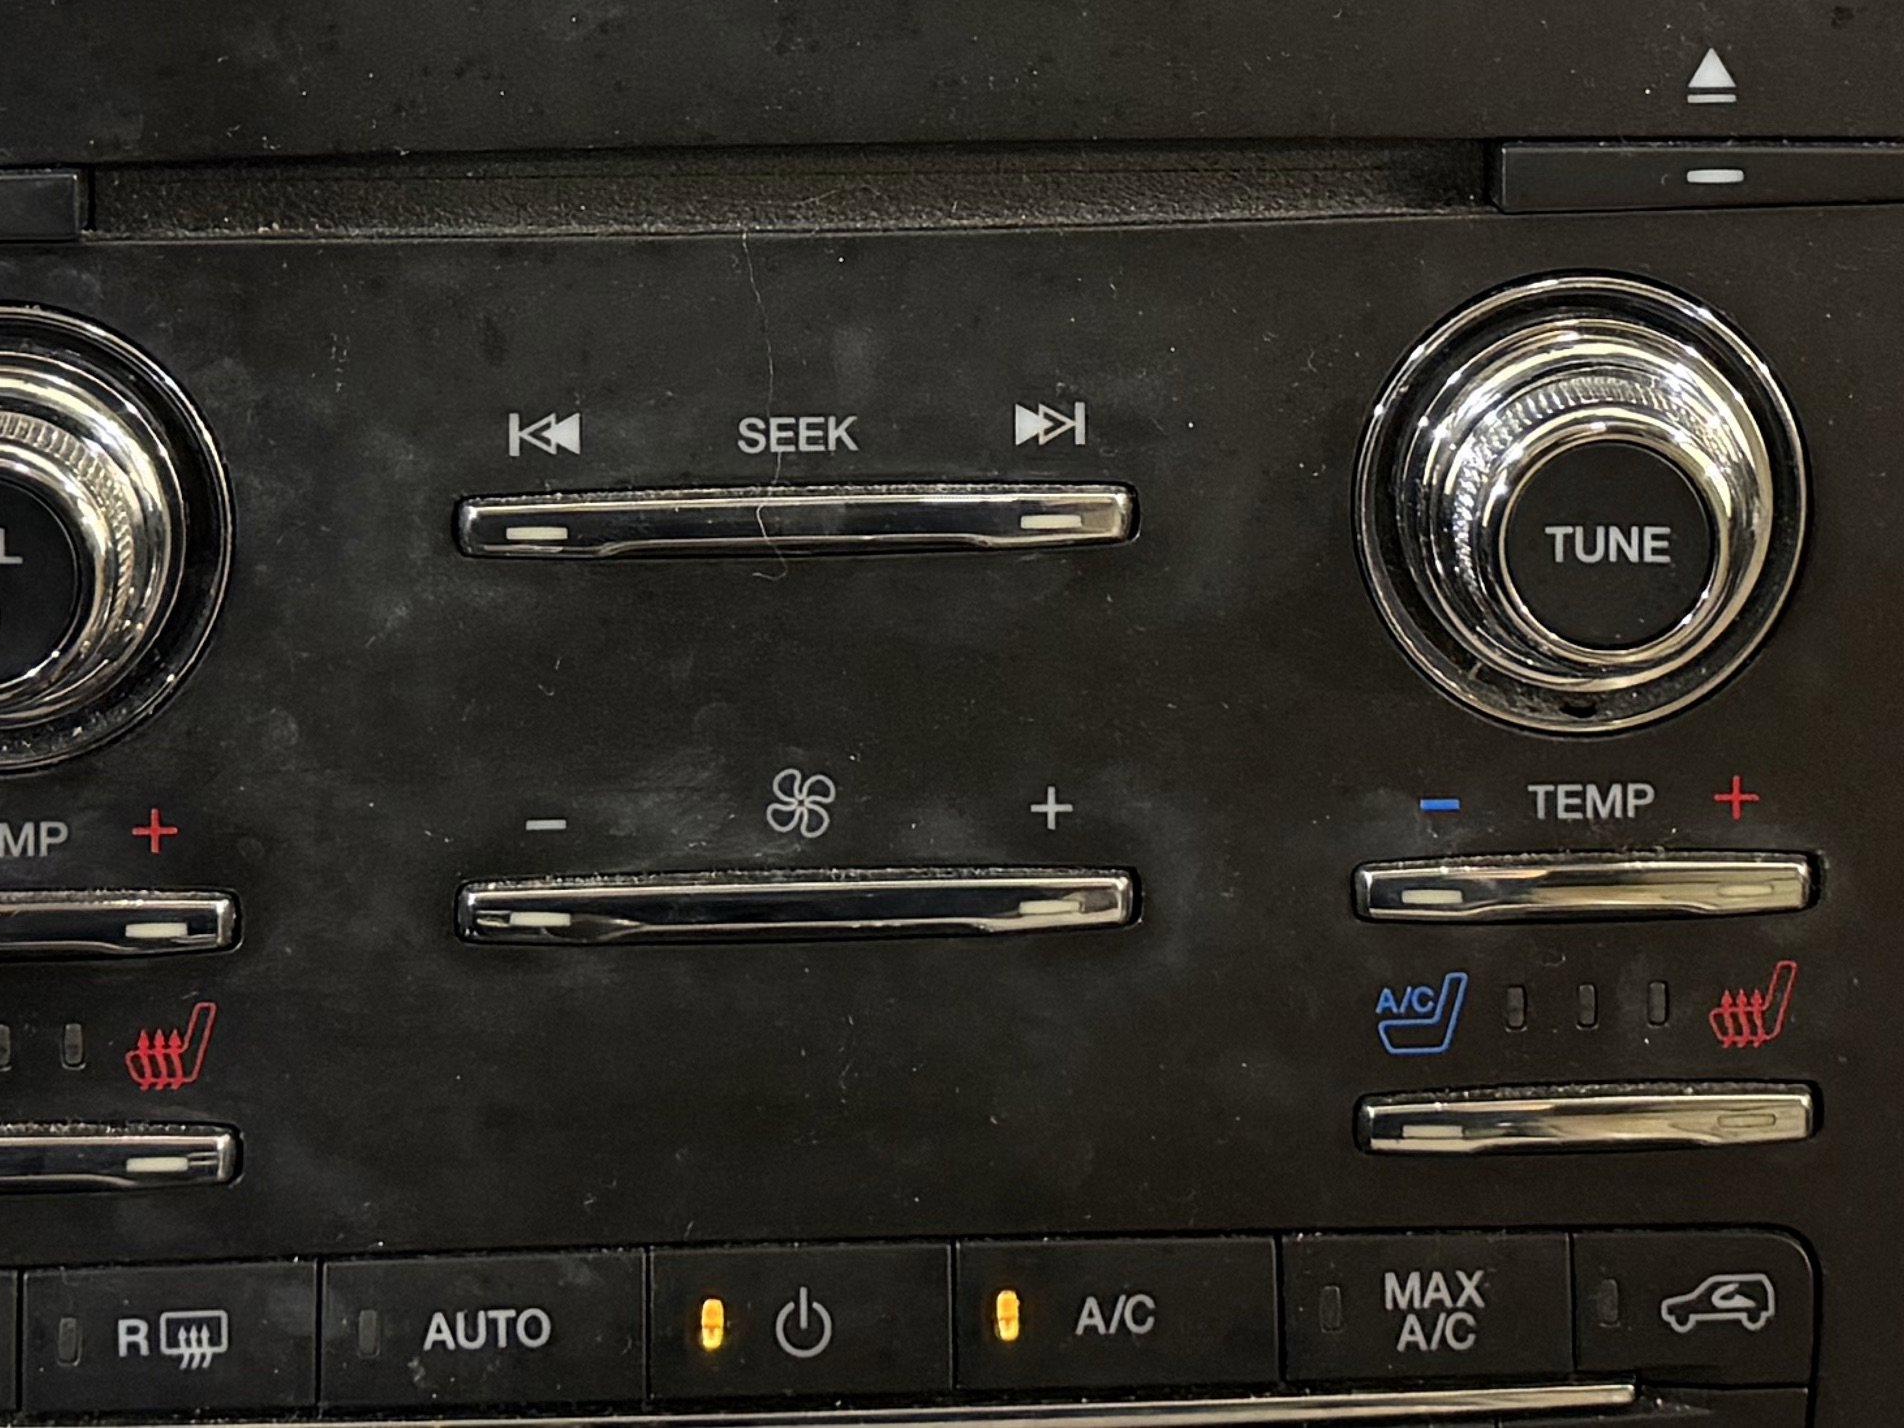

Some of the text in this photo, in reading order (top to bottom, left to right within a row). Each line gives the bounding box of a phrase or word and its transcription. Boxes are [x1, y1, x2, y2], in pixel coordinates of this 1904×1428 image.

[738, 416, 859, 453] SEEK
[1544, 526, 1672, 564] TUNE
[1527, 783, 1656, 820] TEMP
[1375, 985, 1435, 1016] A/C
[1383, 1271, 1486, 1311] MAX
[422, 1308, 552, 1351] AUTO
[1074, 1296, 1157, 1335] A/C
[1396, 1311, 1477, 1351] A/C
[117, 1319, 151, 1357] R
